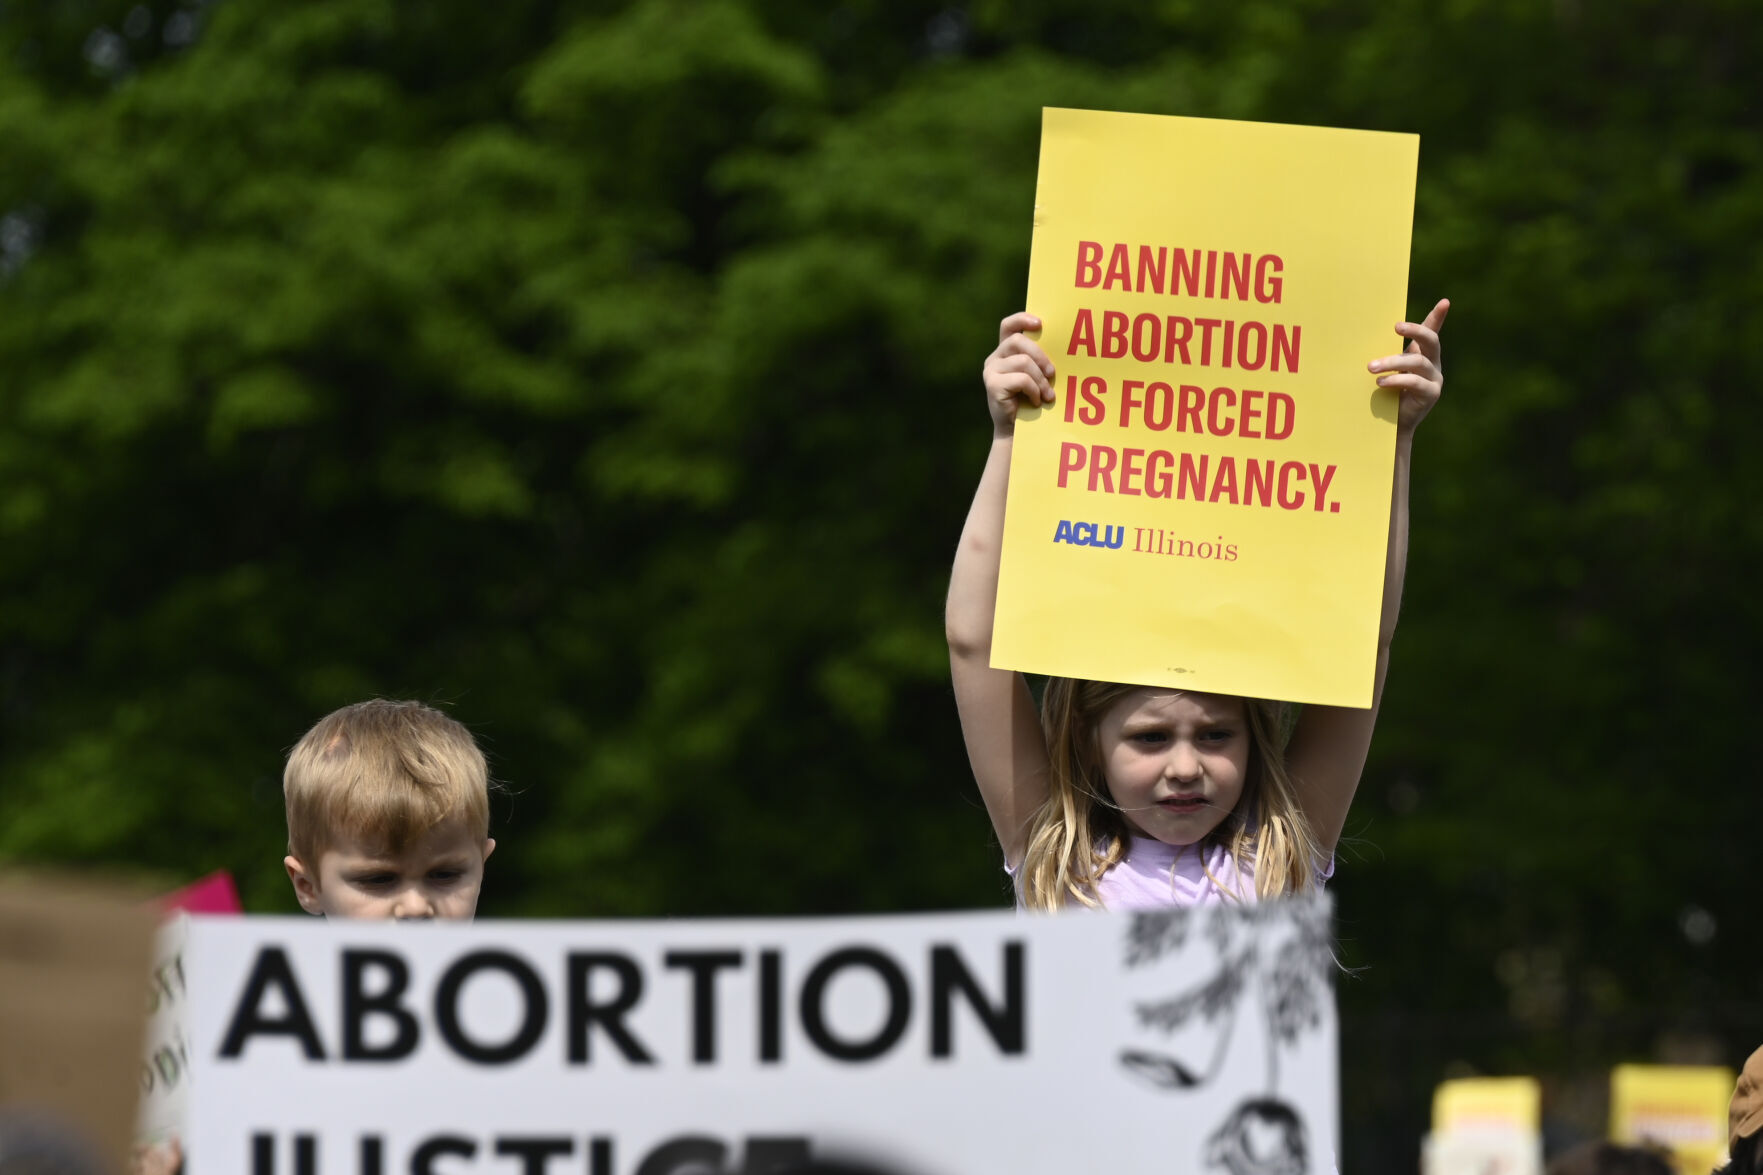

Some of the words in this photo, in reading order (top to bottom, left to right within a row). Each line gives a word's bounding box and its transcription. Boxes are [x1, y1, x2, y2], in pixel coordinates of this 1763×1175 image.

[1074, 240, 1284, 305] BANNING
[1066, 308, 1302, 374] ABORTION
[1063, 375, 1108, 426] IS
[1119, 379, 1296, 441] FORCED
[1057, 441, 1341, 513] PREGNANCY.
[1053, 519, 1125, 550] ACLU
[1132, 526, 1239, 563] Illinois
[217, 940, 1028, 1068] ABORTION
